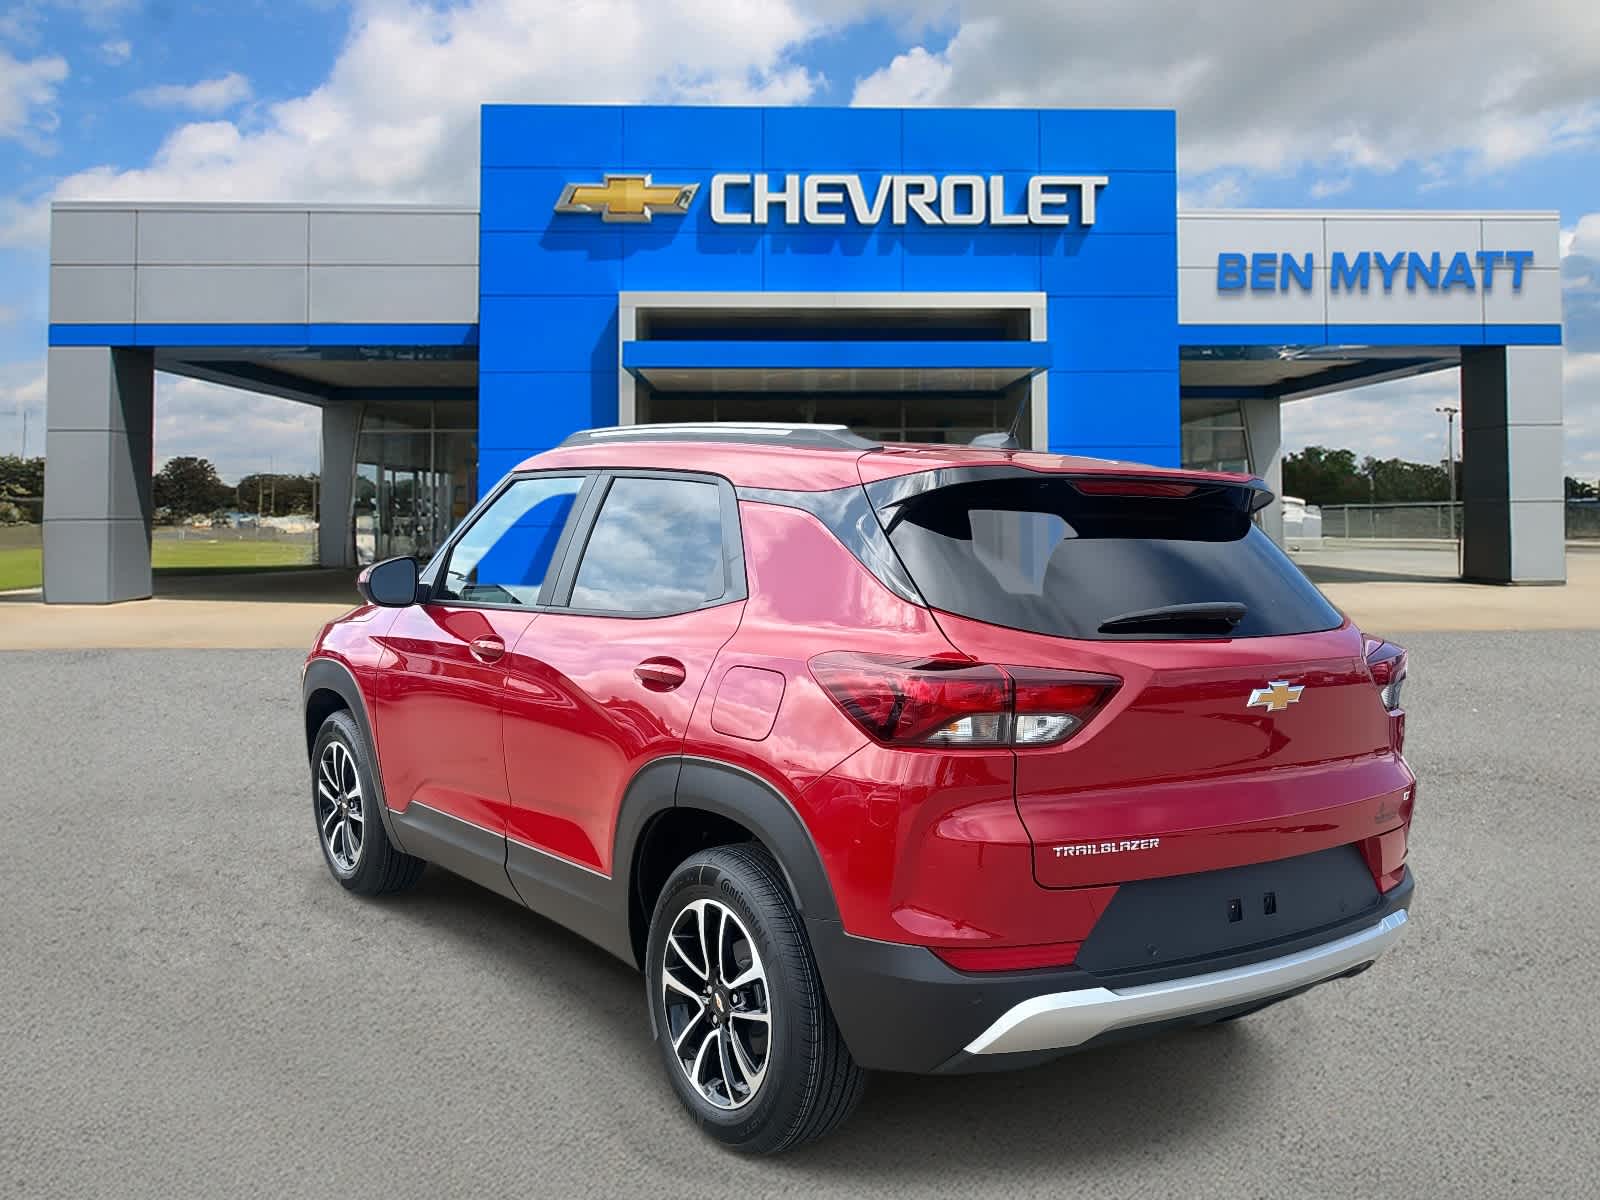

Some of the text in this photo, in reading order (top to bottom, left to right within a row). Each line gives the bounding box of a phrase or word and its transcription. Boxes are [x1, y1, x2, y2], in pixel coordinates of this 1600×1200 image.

[710, 173, 1109, 226] CHEVROLET
[1216, 250, 1534, 291] BEN MYNATT
[1052, 838, 1160, 857] TRAILBLAZER
